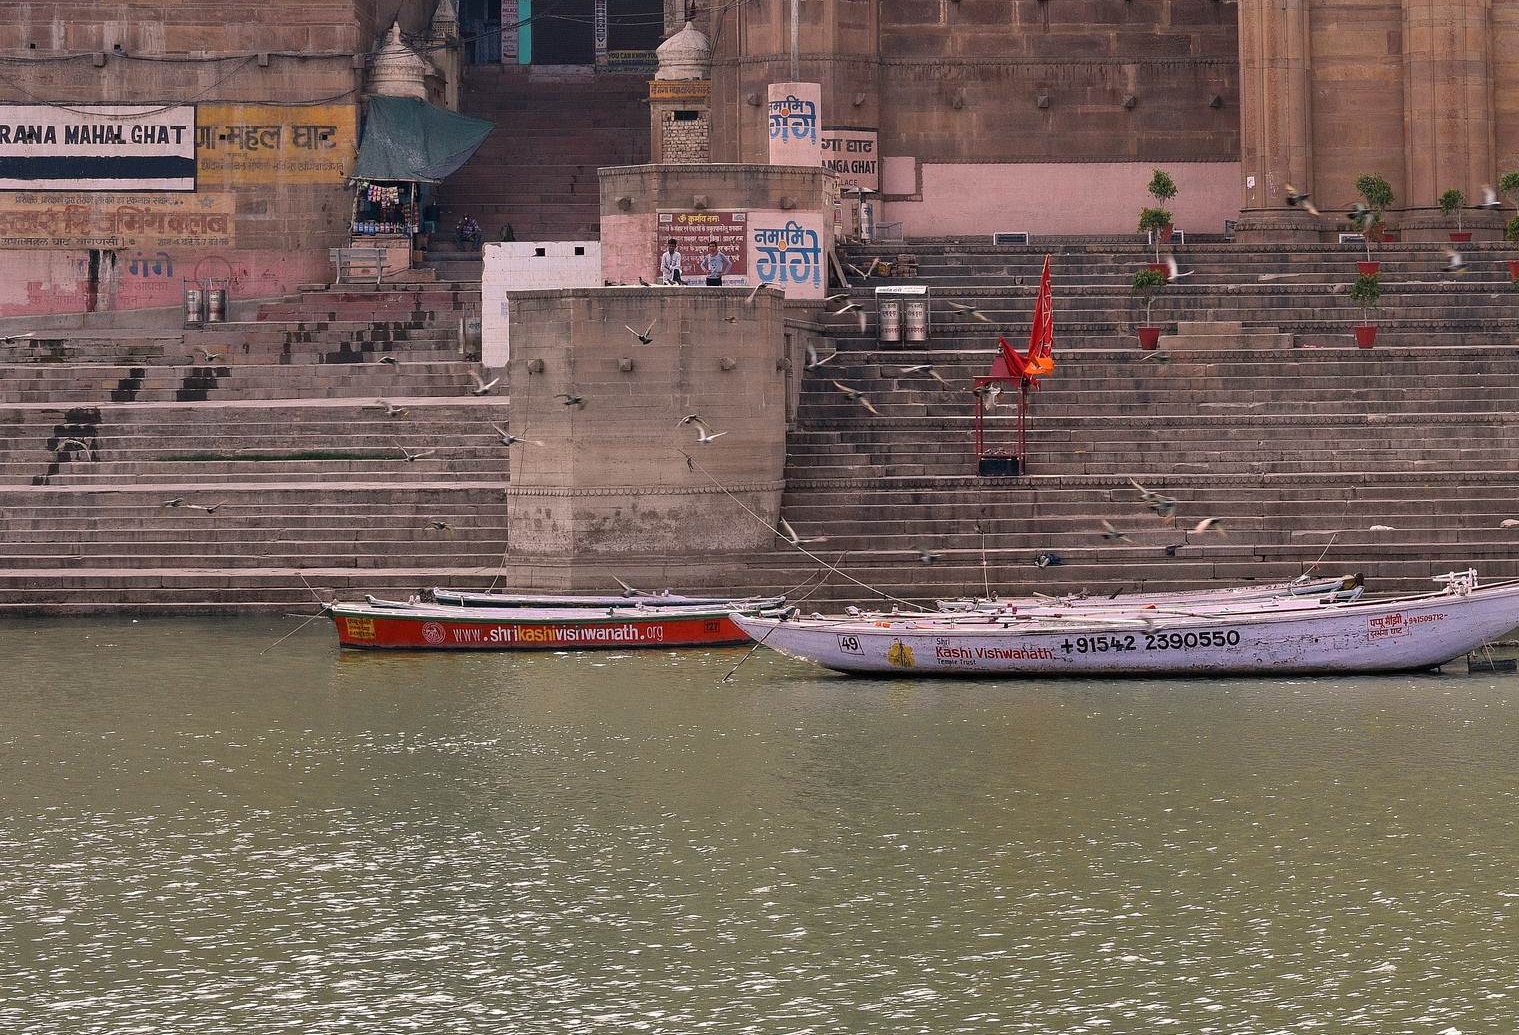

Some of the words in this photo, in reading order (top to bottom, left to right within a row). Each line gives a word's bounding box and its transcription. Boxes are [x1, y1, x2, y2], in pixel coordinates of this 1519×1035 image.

[64, 124, 127, 145] MAHAL
[131, 124, 187, 145] GHAT
[291, 125, 337, 150] घाट
[846, 139, 874, 153] घाट
[851, 160, 877, 174] GHAT
[754, 220, 806, 246] नमामि
[452, 625, 664, 643] www.shrikashivishwanath.org
[1060, 635, 1137, 654] +91542
[1145, 629, 1241, 650] 2390550
[841, 637, 859, 651] 49
[936, 646, 972, 659] Kashi
[937, 658, 959, 666] Temple
[960, 658, 977, 666] Trust
